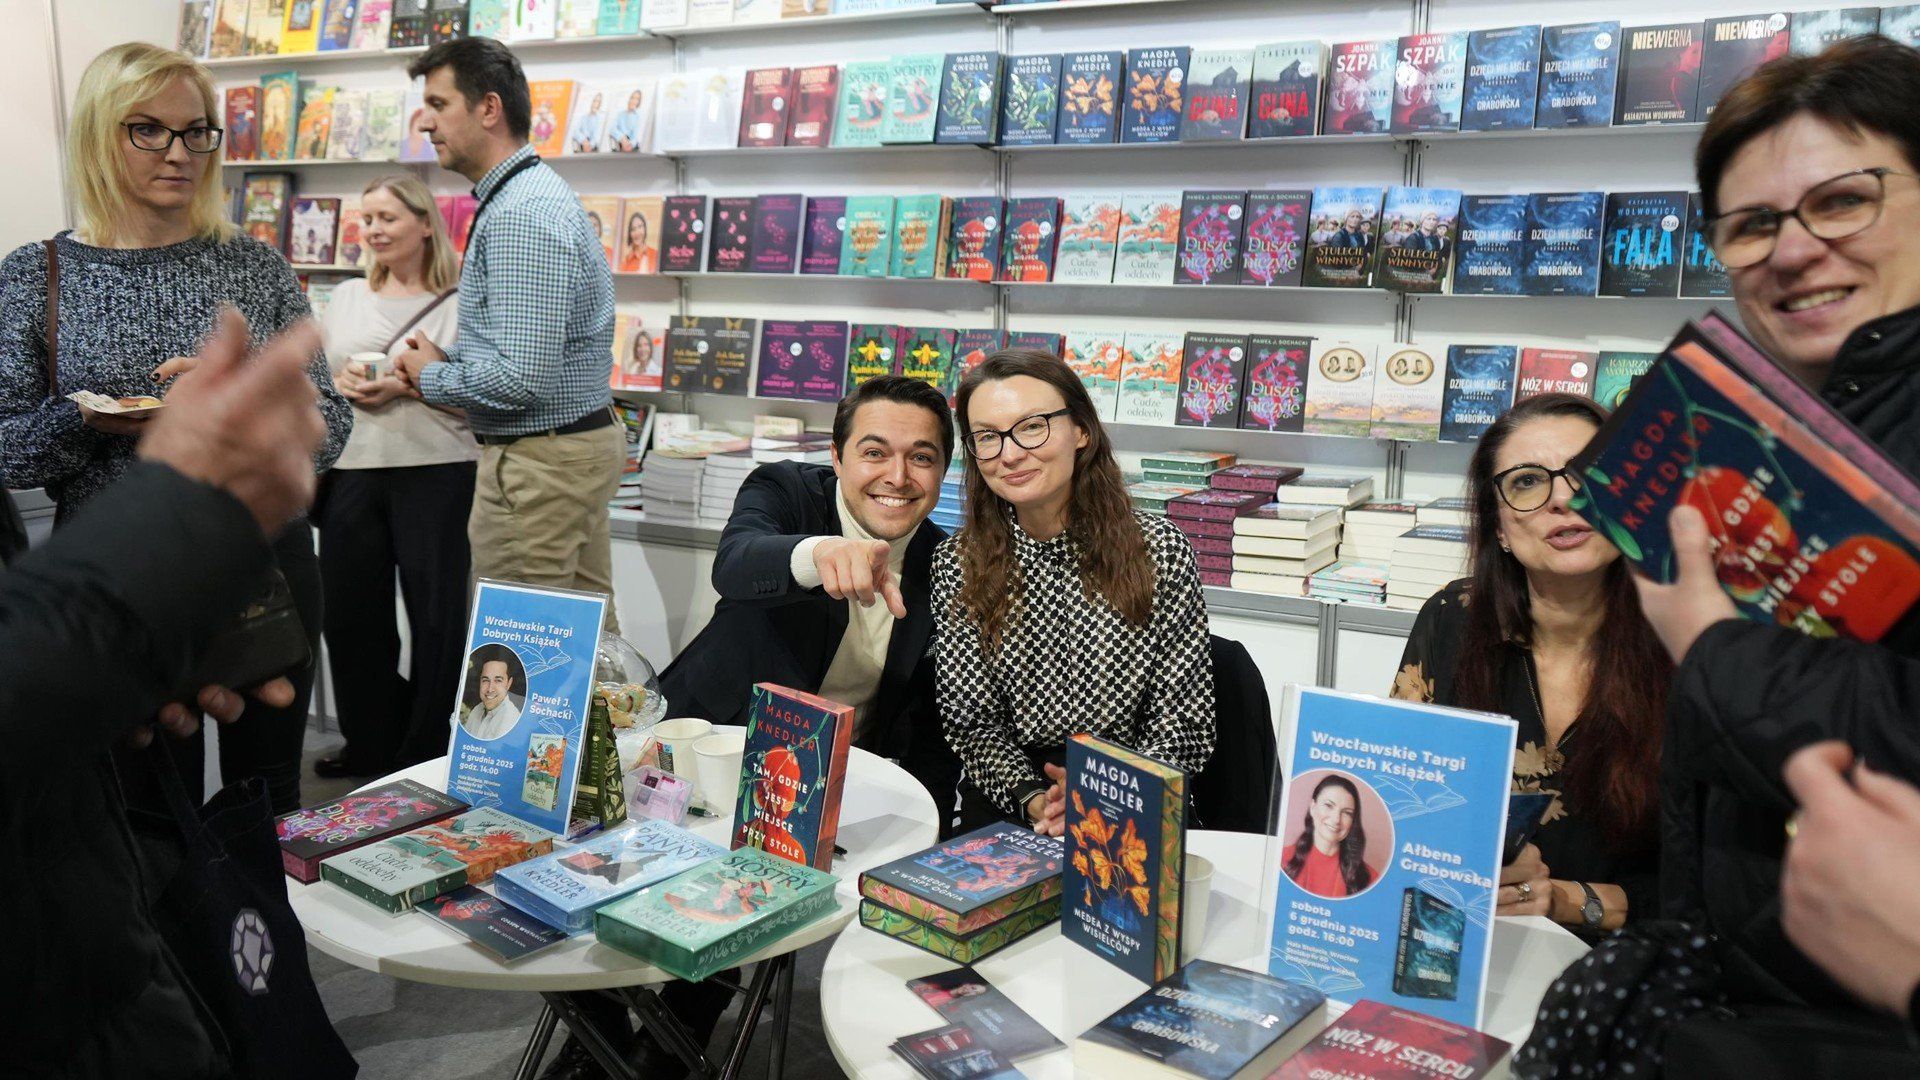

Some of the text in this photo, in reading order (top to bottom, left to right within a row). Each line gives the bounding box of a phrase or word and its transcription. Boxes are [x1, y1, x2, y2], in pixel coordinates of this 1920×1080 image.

[1419, 35, 1447, 46] JOANNA
[1632, 29, 1692, 50] NIEWIERNA
[1075, 54, 1110, 63] MAGDA
[1137, 59, 1180, 69] KNEDLER
[1141, 50, 1176, 59] MAGDA
[1336, 53, 1391, 73] SZPAK
[1403, 44, 1460, 65] SZPAK
[1071, 63, 1111, 72] KNEDLER
[1476, 99, 1520, 111] GRABOWSKA
[1551, 95, 1597, 108] GRABOWSKA
[1185, 236, 1233, 252] Dusze
[1248, 236, 1297, 252] Dusze
[1462, 230, 1487, 241] DZIECI
[1501, 229, 1523, 241] MGLE
[1531, 229, 1556, 240] DZIECI
[1572, 228, 1594, 240] MGLE
[1613, 228, 1673, 266] FALA
[1316, 256, 1364, 267] WINNYCH
[1388, 257, 1439, 270] WINNYCH
[1468, 265, 1512, 276] GRABOWSKA
[1538, 265, 1583, 276] GRABOWSKA
[1609, 358, 1654, 368] KATARZYN
[1187, 377, 1234, 393] Dusze
[1251, 380, 1300, 397] Dusze
[1487, 379, 1507, 391] MGLE
[1544, 379, 1553, 392] W
[1556, 380, 1588, 395] SERCU
[1455, 413, 1496, 424] GRABOWSKA
[1606, 409, 1678, 498] MAGDA
[1723, 465, 1775, 526] GDZIE
[1742, 523, 1785, 572] JEST
[1758, 533, 1830, 614] MIEJSCE
[1818, 546, 1878, 606] STOLE
[484, 615, 573, 637] Wrocławskie Targi
[482, 627, 561, 648] Dobrych Książek
[531, 692, 571, 708] Paweł J.
[529, 705, 572, 720] Sochacki
[765, 706, 811, 731] MAGDA
[757, 720, 816, 752] KNEDLER
[462, 743, 487, 755] sobota
[1312, 730, 1467, 771] Wrocławskie Targi
[459, 762, 499, 776] godz. 14:00
[467, 754, 495, 767] grudnia
[496, 759, 514, 769] 2025
[1309, 747, 1447, 784] Dobrych Książek
[752, 763, 808, 794] TAM, GDZIE
[1085, 755, 1140, 793] MAGDA
[765, 791, 788, 807] JEST
[1080, 774, 1145, 815] KNEDLER
[753, 810, 795, 834] MIEJSCE
[742, 825, 800, 859] PRZY STOLE
[995, 831, 1064, 860] KNEDLER
[375, 851, 414, 872] Cudze
[1402, 841, 1462, 865] Ałbena
[348, 856, 400, 882] oddechy
[722, 856, 817, 891] SIOSTRY
[1400, 858, 1492, 889] Grabowska
[525, 870, 578, 901] KNEDLER
[542, 867, 587, 893] MAGDA
[900, 872, 930, 887] WYSPY
[931, 886, 965, 902] OGNIA
[919, 873, 951, 890] MEDEA
[1290, 901, 1331, 917] sobota
[1074, 907, 1141, 950] MEDEA Z WYSPY
[1288, 923, 1355, 948] godz. 16:00
[1289, 911, 1379, 942] 6 grudnia 2025
[1082, 921, 1131, 957] WISIELCÓW
[1131, 1019, 1220, 1055] GRABOWSKA
[1324, 1026, 1376, 1048] NÓŻ
[1373, 1038, 1400, 1054] W
[1396, 1045, 1475, 1080] SERCU
